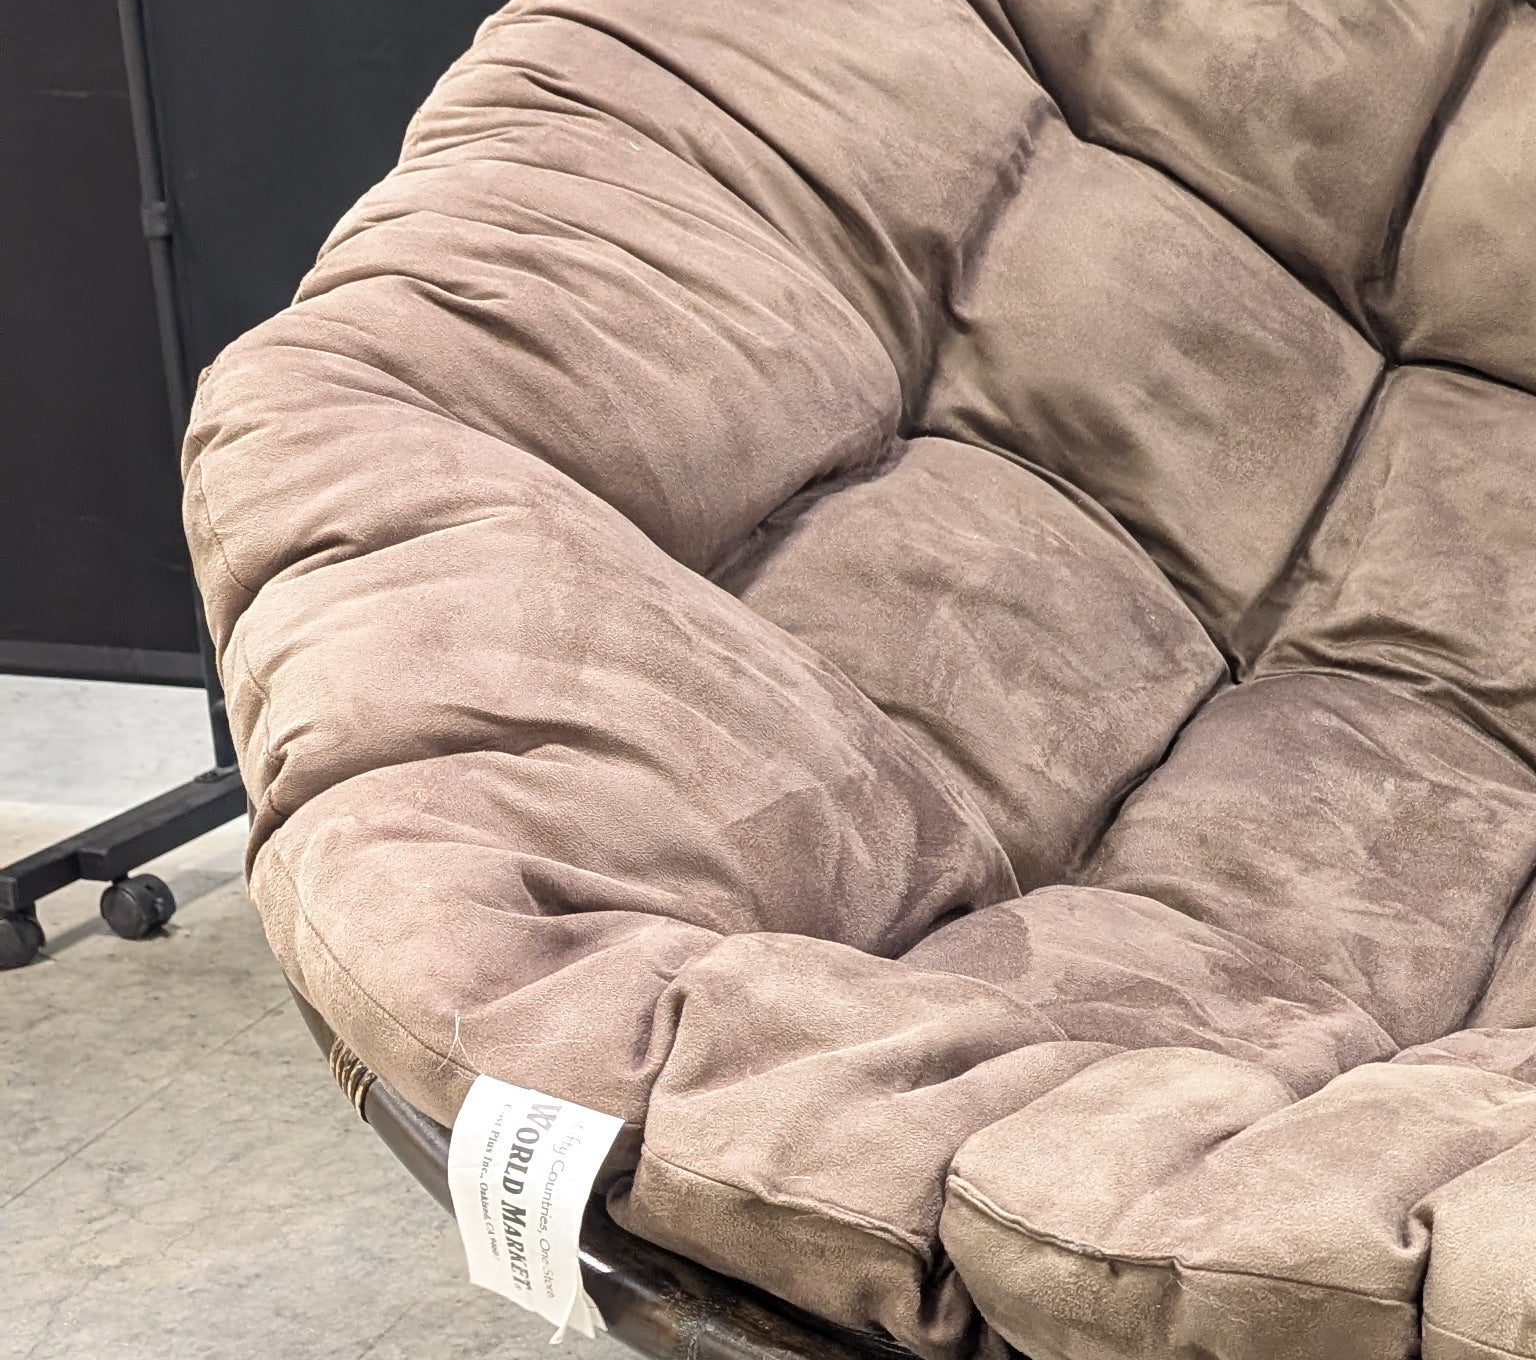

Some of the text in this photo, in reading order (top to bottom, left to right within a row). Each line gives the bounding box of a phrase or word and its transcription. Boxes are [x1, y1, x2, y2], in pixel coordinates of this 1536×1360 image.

[495, 1104, 513, 1127] Cst
[485, 1131, 500, 1154] Plus
[501, 1102, 562, 1194] WORLD
[536, 1160, 566, 1233] Countries,
[539, 1237, 552, 1265] One
